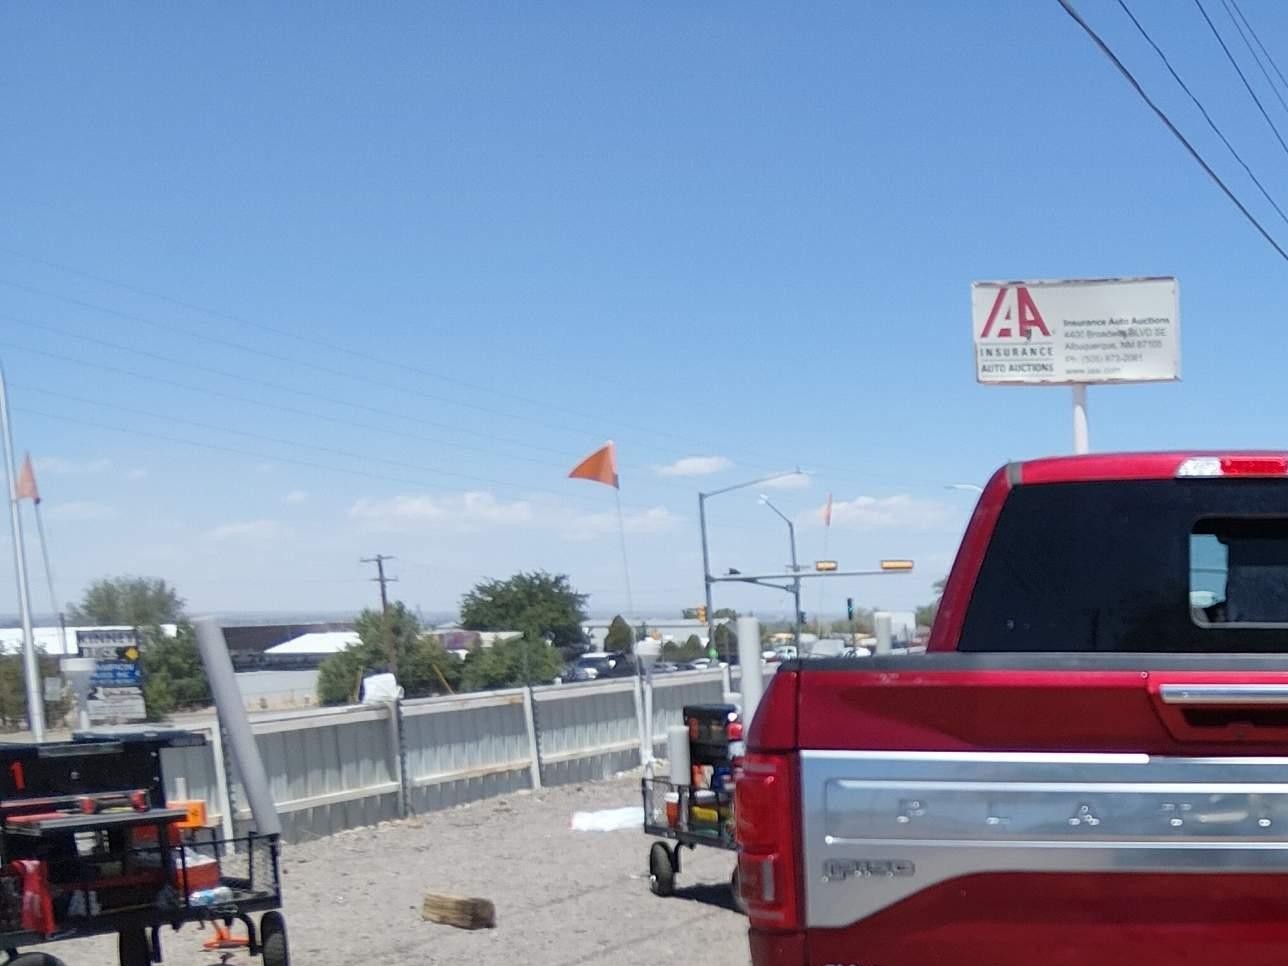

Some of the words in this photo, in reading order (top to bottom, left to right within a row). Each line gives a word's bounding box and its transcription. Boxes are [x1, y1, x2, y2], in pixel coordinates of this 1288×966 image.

[1131, 316, 1170, 325] Auctions
[980, 348, 1054, 357] INSURANCE
[981, 364, 1005, 373] AUTO
[1009, 363, 1054, 372] AUCTIONS
